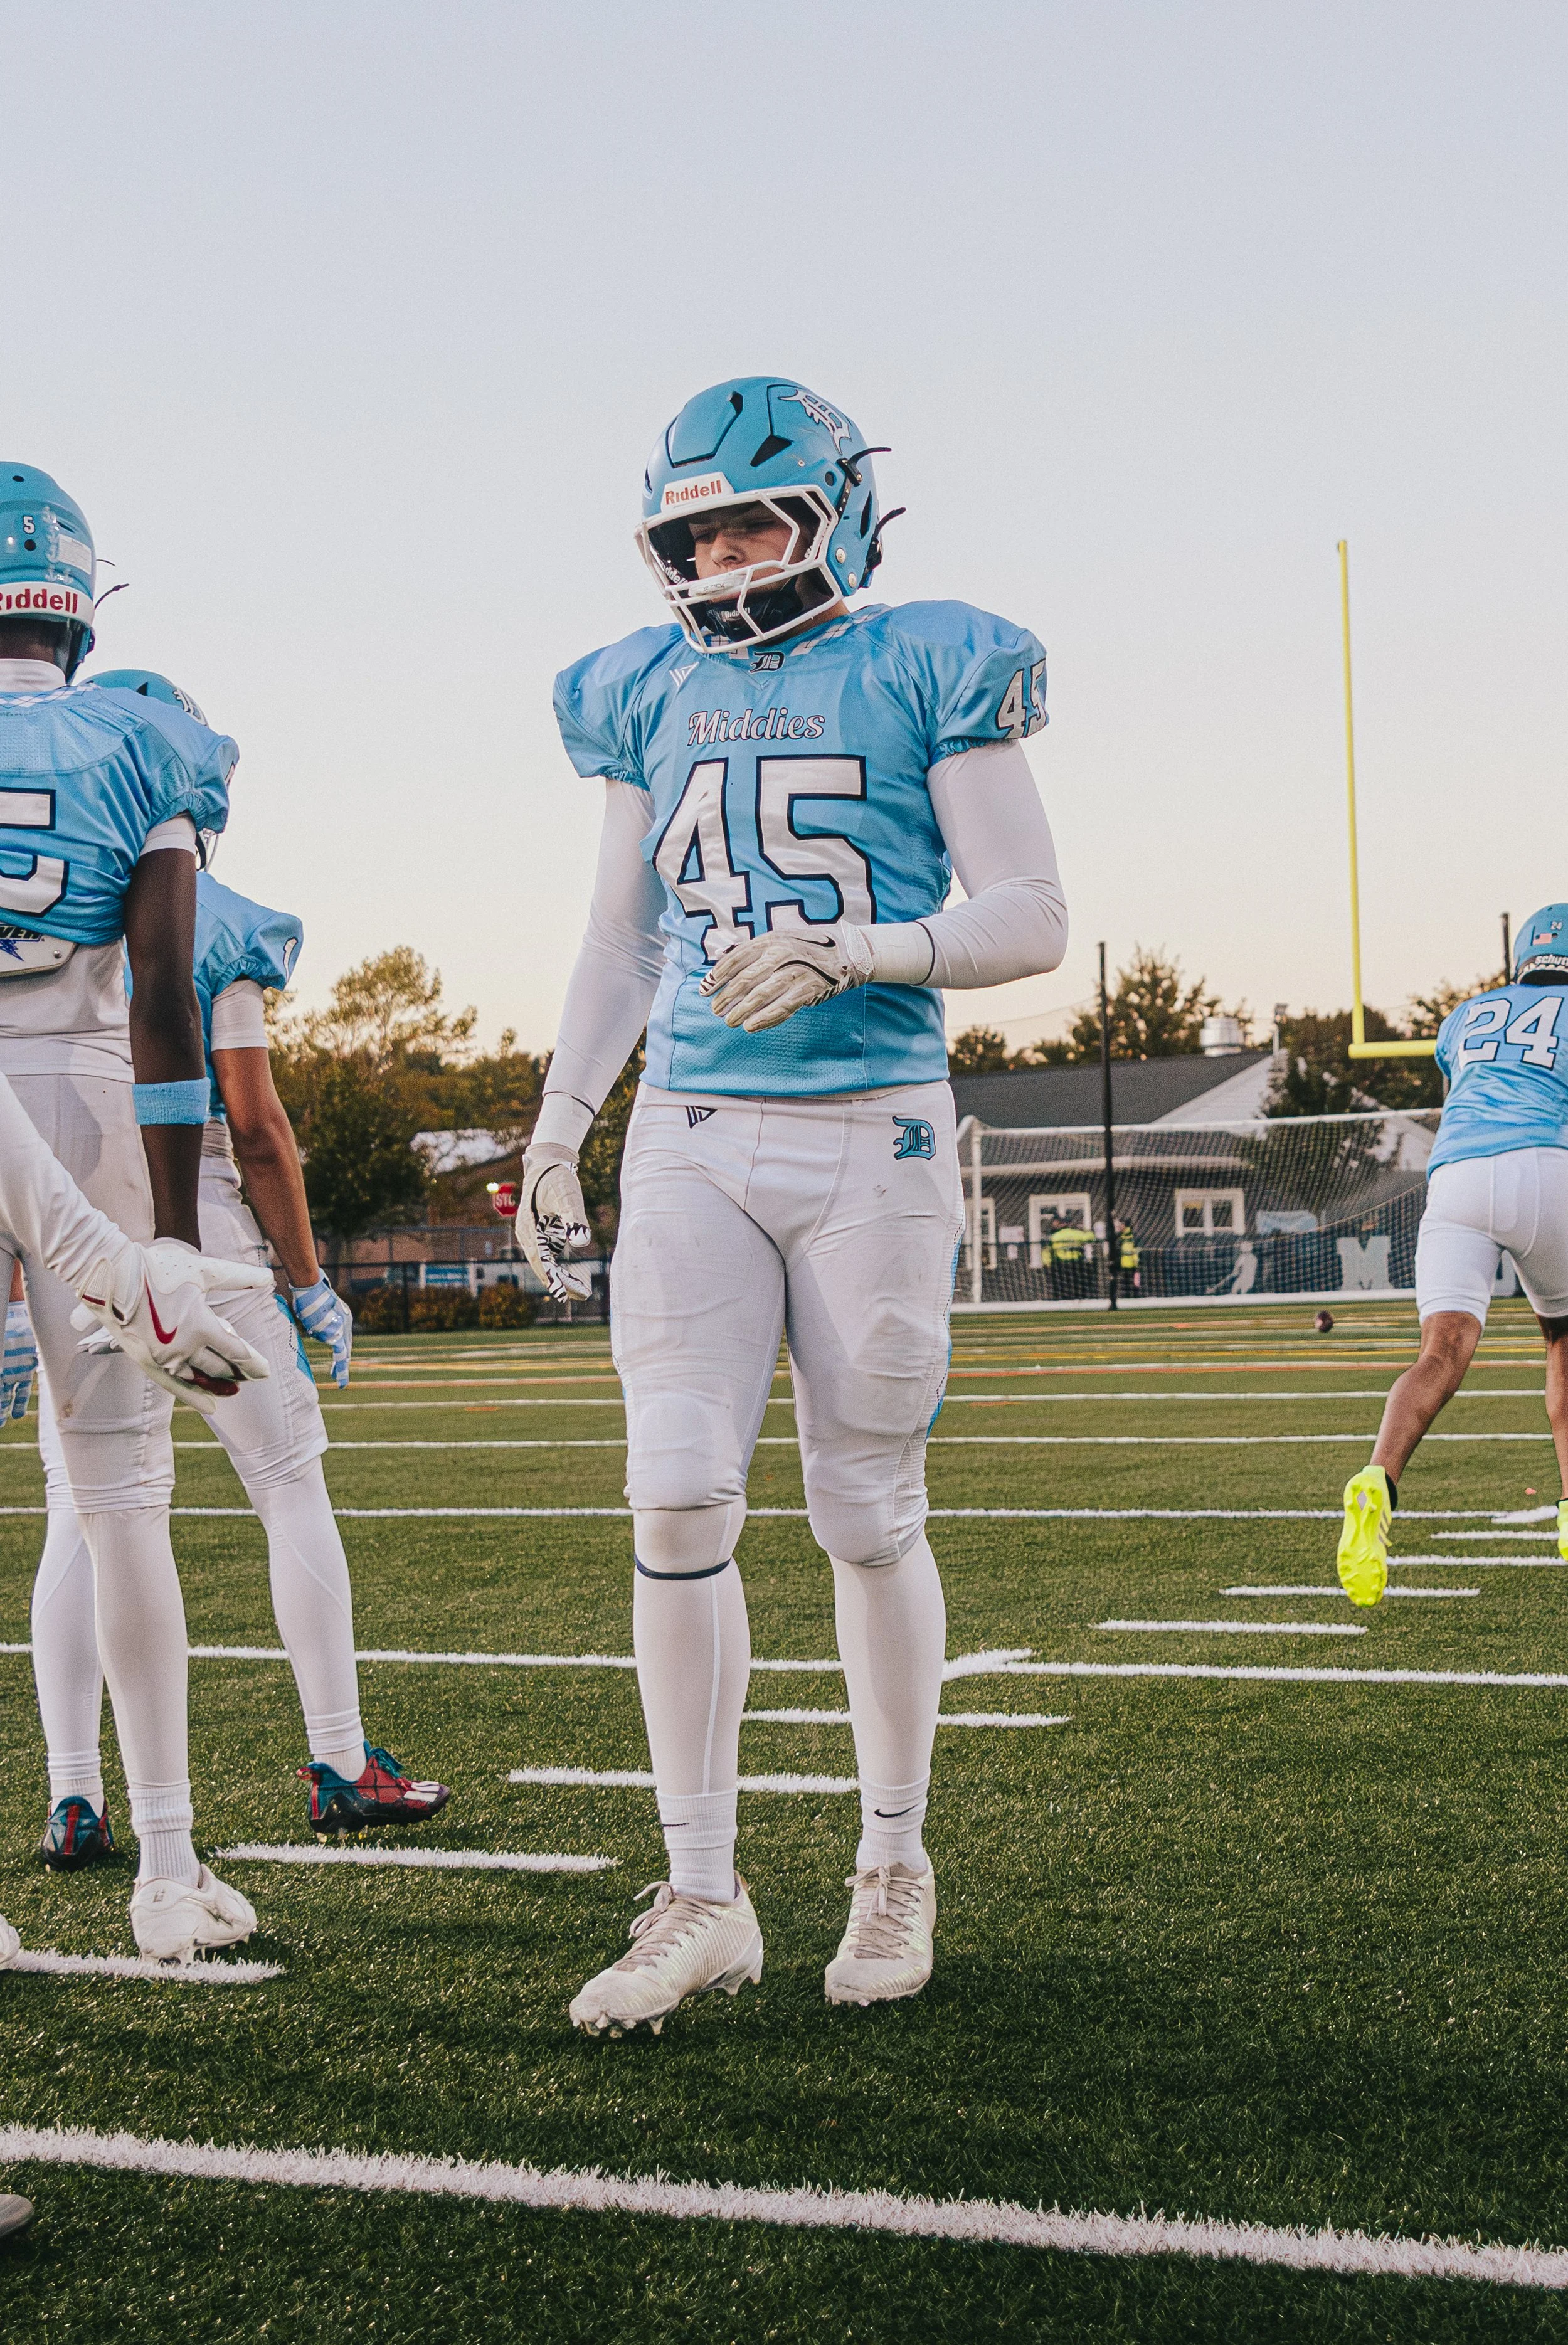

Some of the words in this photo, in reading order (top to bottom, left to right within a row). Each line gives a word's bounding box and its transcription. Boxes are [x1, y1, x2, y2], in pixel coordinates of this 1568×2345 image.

[665, 480, 722, 505] Riddell
[23, 515, 36, 534] 5
[749, 651, 785, 674] D
[995, 658, 1046, 739] 45
[687, 707, 825, 746] Middies
[652, 754, 877, 965] 45
[1550, 920, 1562, 931] 24
[1458, 995, 1564, 1071] 24
[892, 1116, 936, 1160] D
